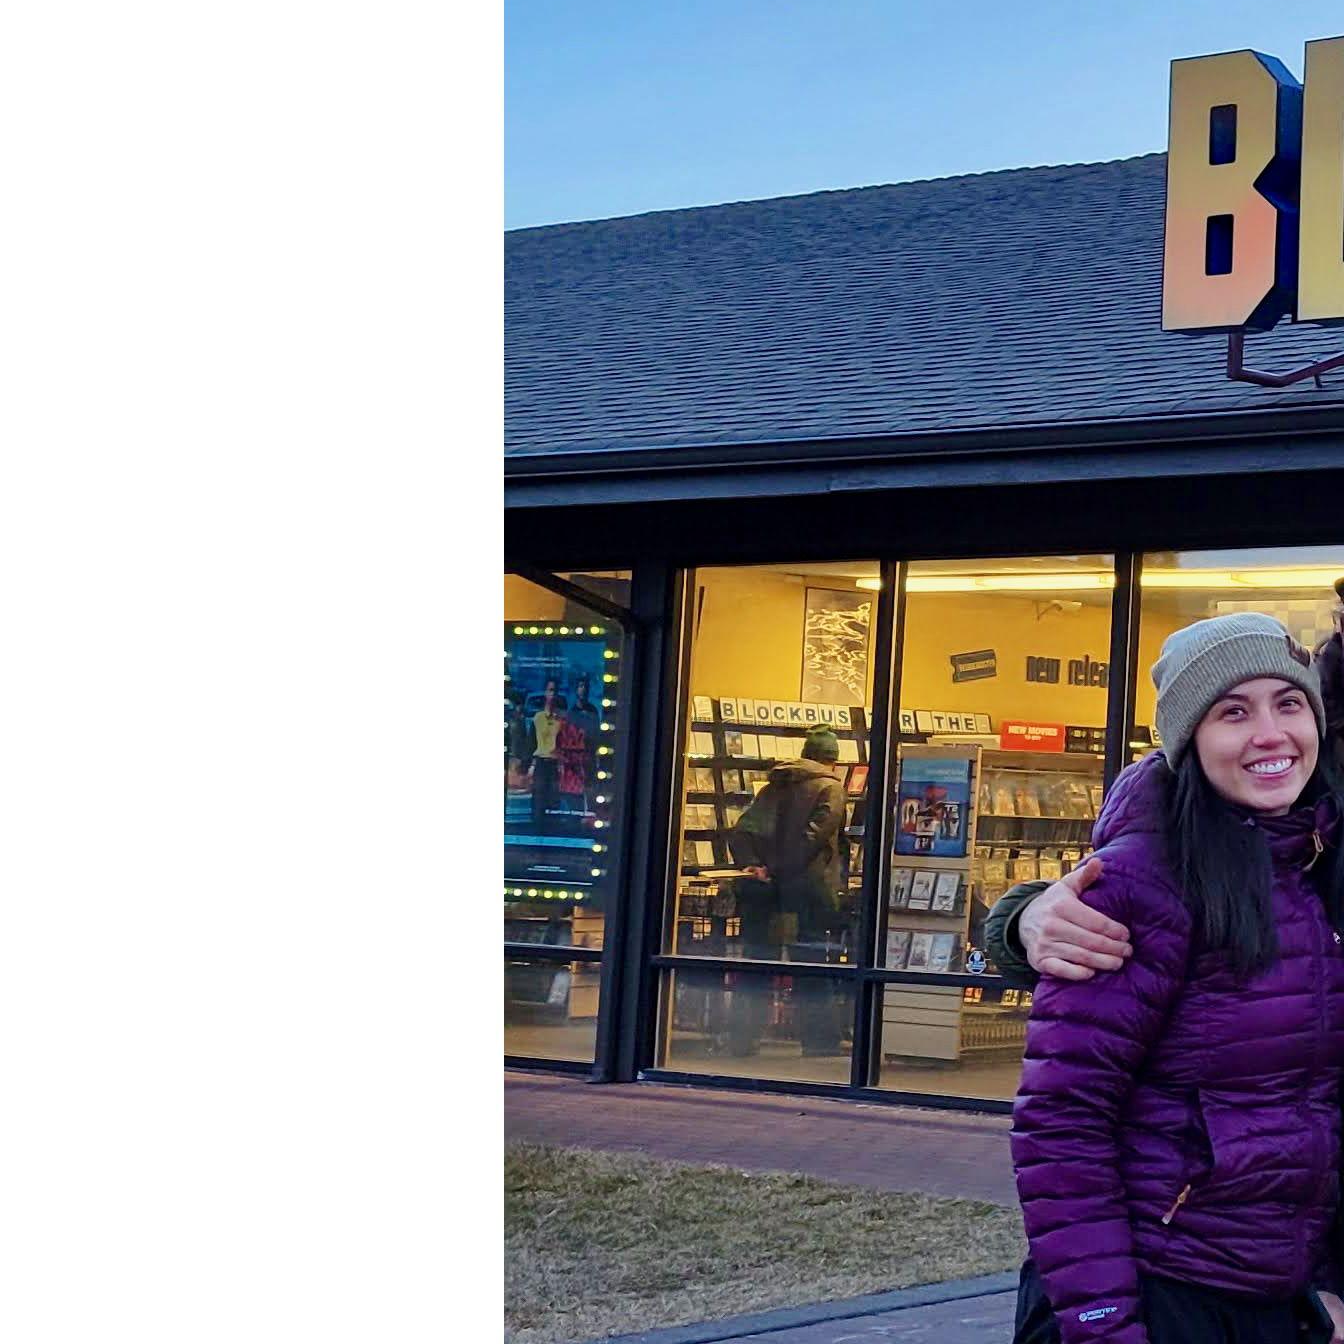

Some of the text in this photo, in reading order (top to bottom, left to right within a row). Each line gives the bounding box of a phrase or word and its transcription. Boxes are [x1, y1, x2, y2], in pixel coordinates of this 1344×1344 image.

[1026, 654, 1110, 688] new relea
[722, 702, 974, 731] BLOCKBUSR THE
[1008, 725, 1058, 736] NEW MOVIES
